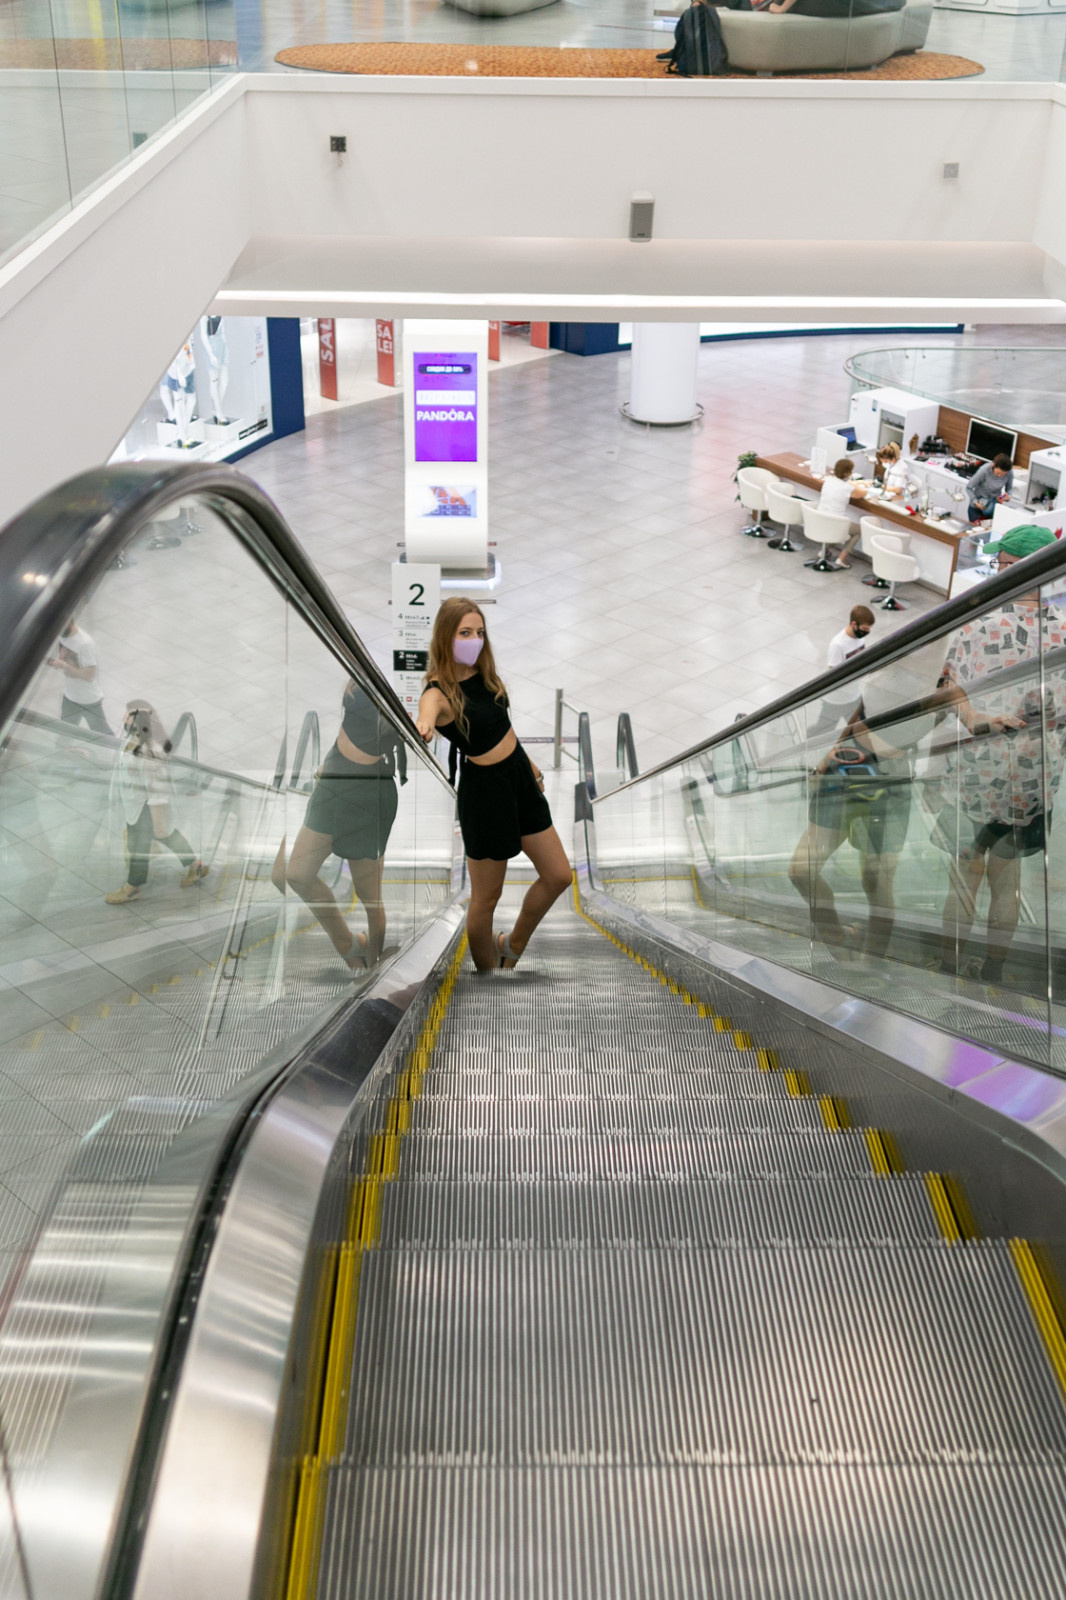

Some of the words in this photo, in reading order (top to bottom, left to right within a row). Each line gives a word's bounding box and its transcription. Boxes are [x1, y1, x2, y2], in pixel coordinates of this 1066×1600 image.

[376, 324, 393, 340] SA
[408, 583, 425, 606] 2
[399, 651, 405, 659] 2
